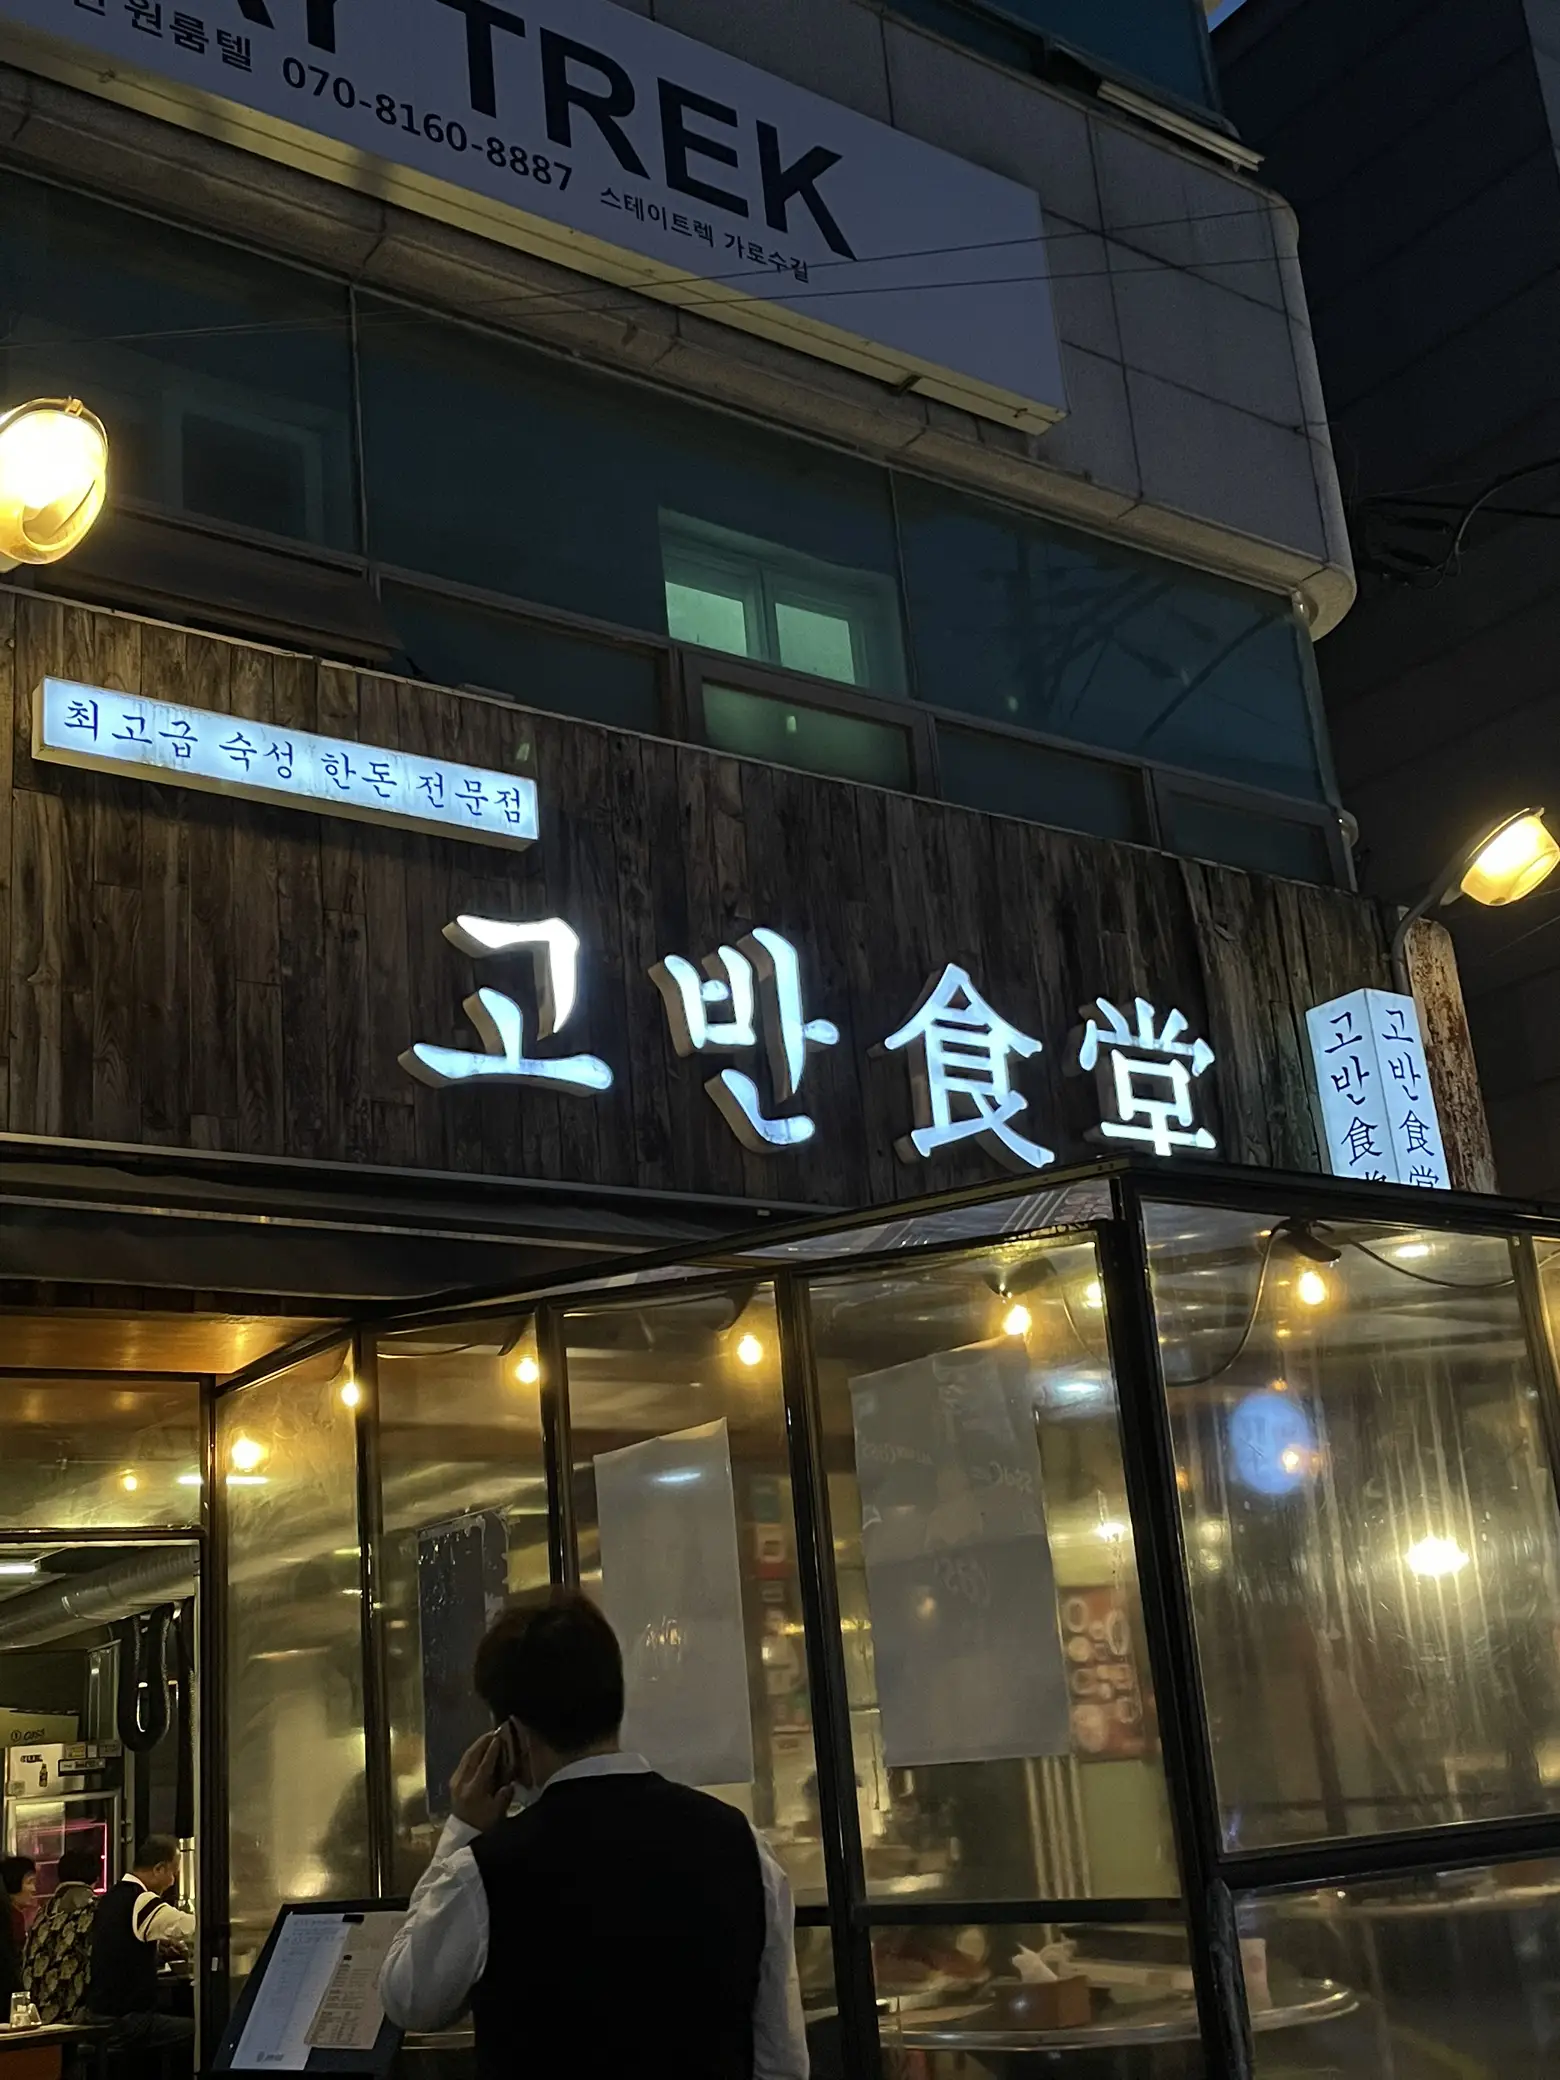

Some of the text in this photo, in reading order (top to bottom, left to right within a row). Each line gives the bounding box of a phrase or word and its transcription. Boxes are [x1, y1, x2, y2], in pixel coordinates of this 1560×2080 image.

[282, 57, 573, 191] 070-8160-8887
[600, 187, 809, 283] 스테이트렉 가로수길
[64, 699, 522, 823] 최고급 숙성 한돈 전문점
